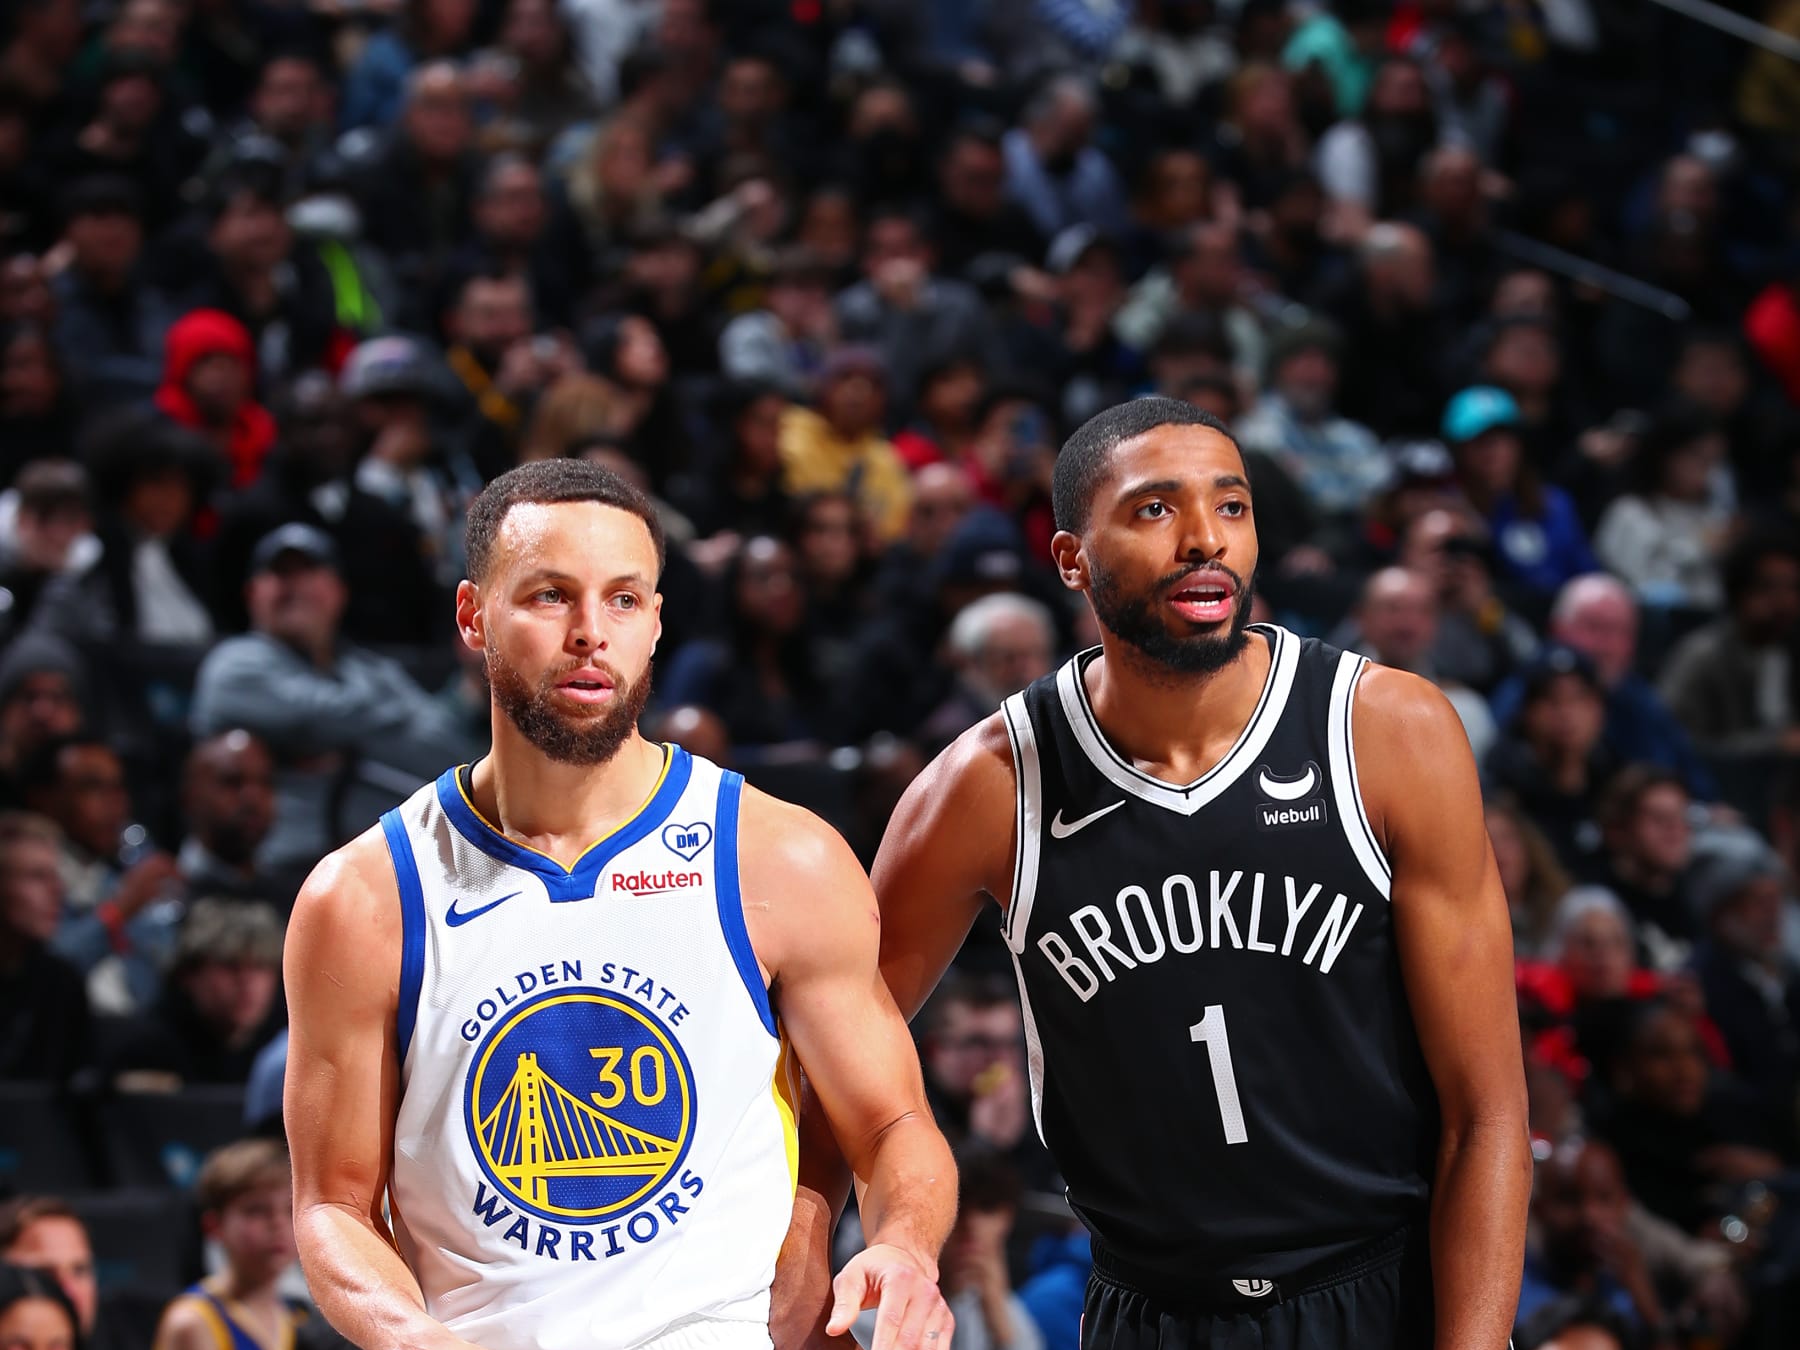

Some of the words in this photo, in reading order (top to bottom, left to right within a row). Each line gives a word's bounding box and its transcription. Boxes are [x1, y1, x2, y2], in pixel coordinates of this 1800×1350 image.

[676, 833, 699, 848] DM
[1263, 806, 1320, 826] Webull
[612, 870, 702, 891] Rakuten
[1037, 870, 1364, 1003] BROOKLYN
[460, 959, 582, 1043] GOLDEN
[601, 962, 691, 1028] STATE
[588, 1046, 667, 1109] 30
[1189, 1004, 1249, 1145] 1
[471, 1167, 704, 1262] WARRIORS
